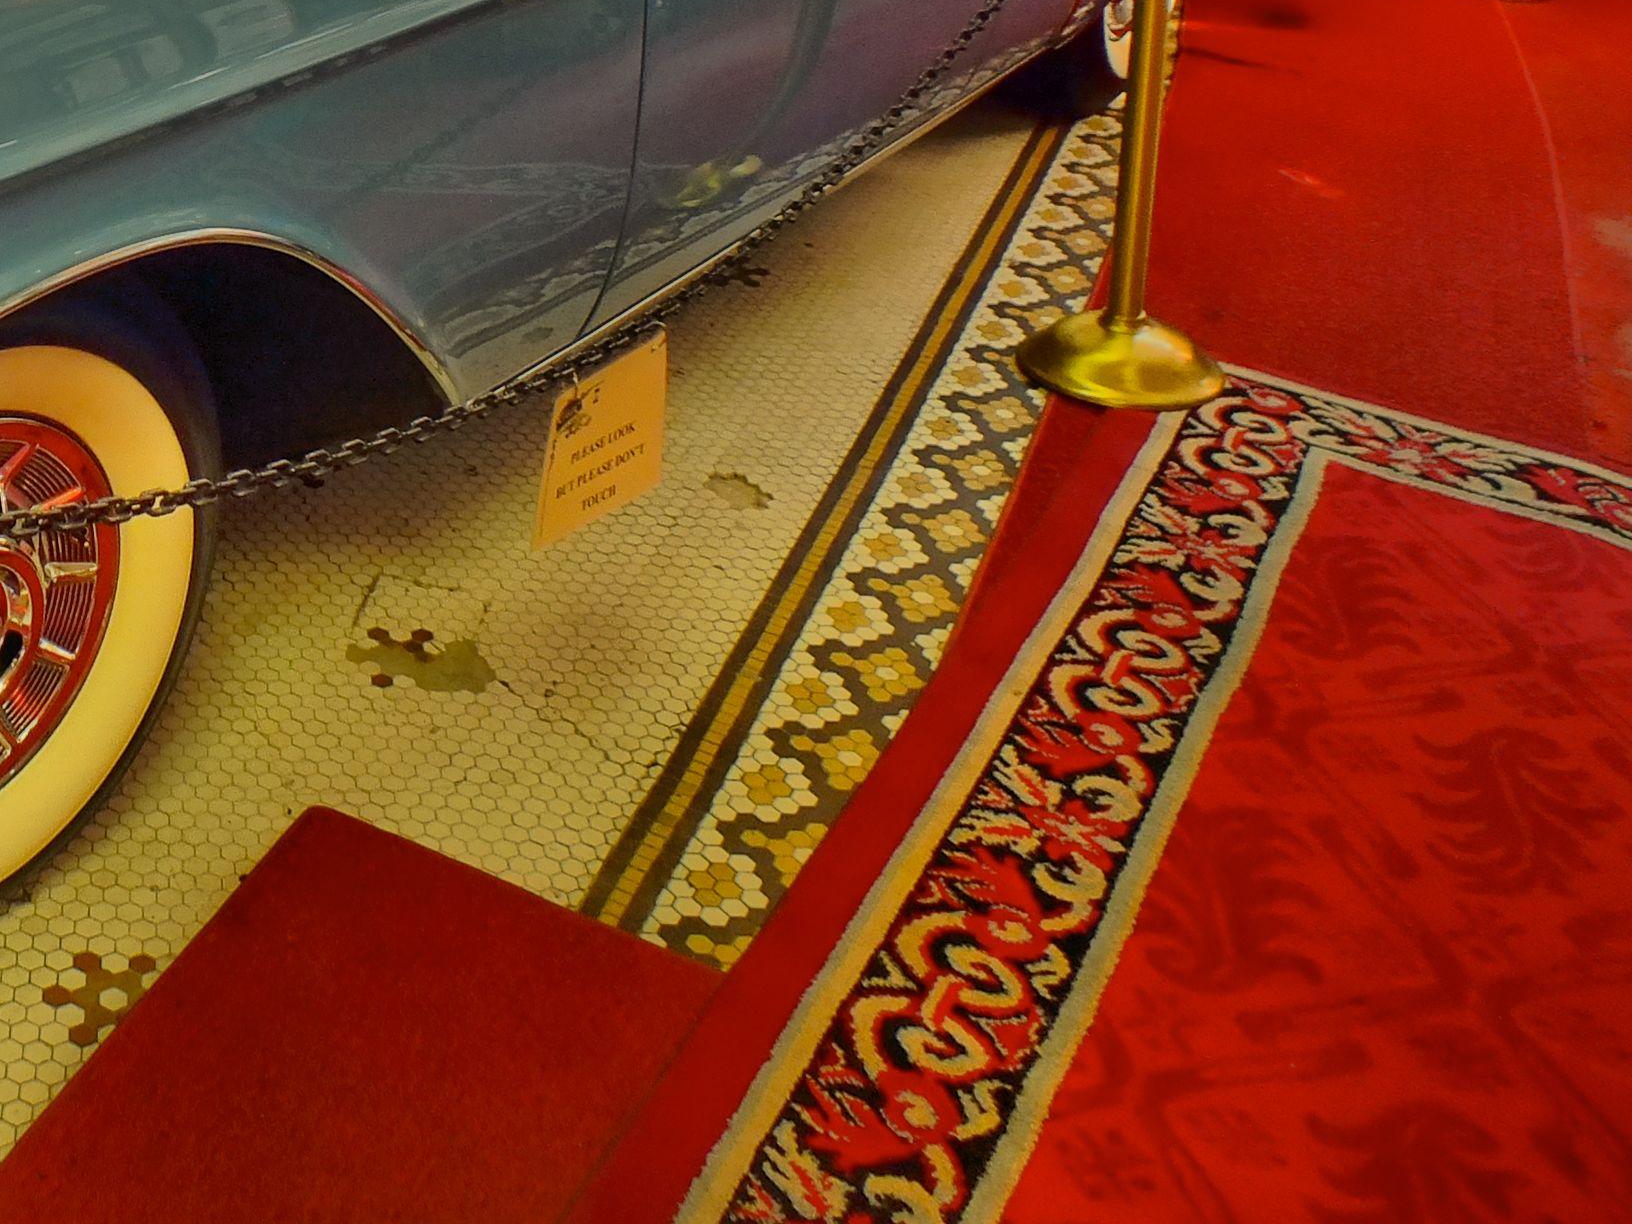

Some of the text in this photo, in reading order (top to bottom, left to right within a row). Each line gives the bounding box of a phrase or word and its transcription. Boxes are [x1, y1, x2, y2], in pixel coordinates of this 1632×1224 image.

[571, 421, 636, 465] PLEASE LOOK
[556, 478, 575, 499] BUT
[577, 458, 614, 487] PLEASE
[581, 484, 617, 511] TOUCH
